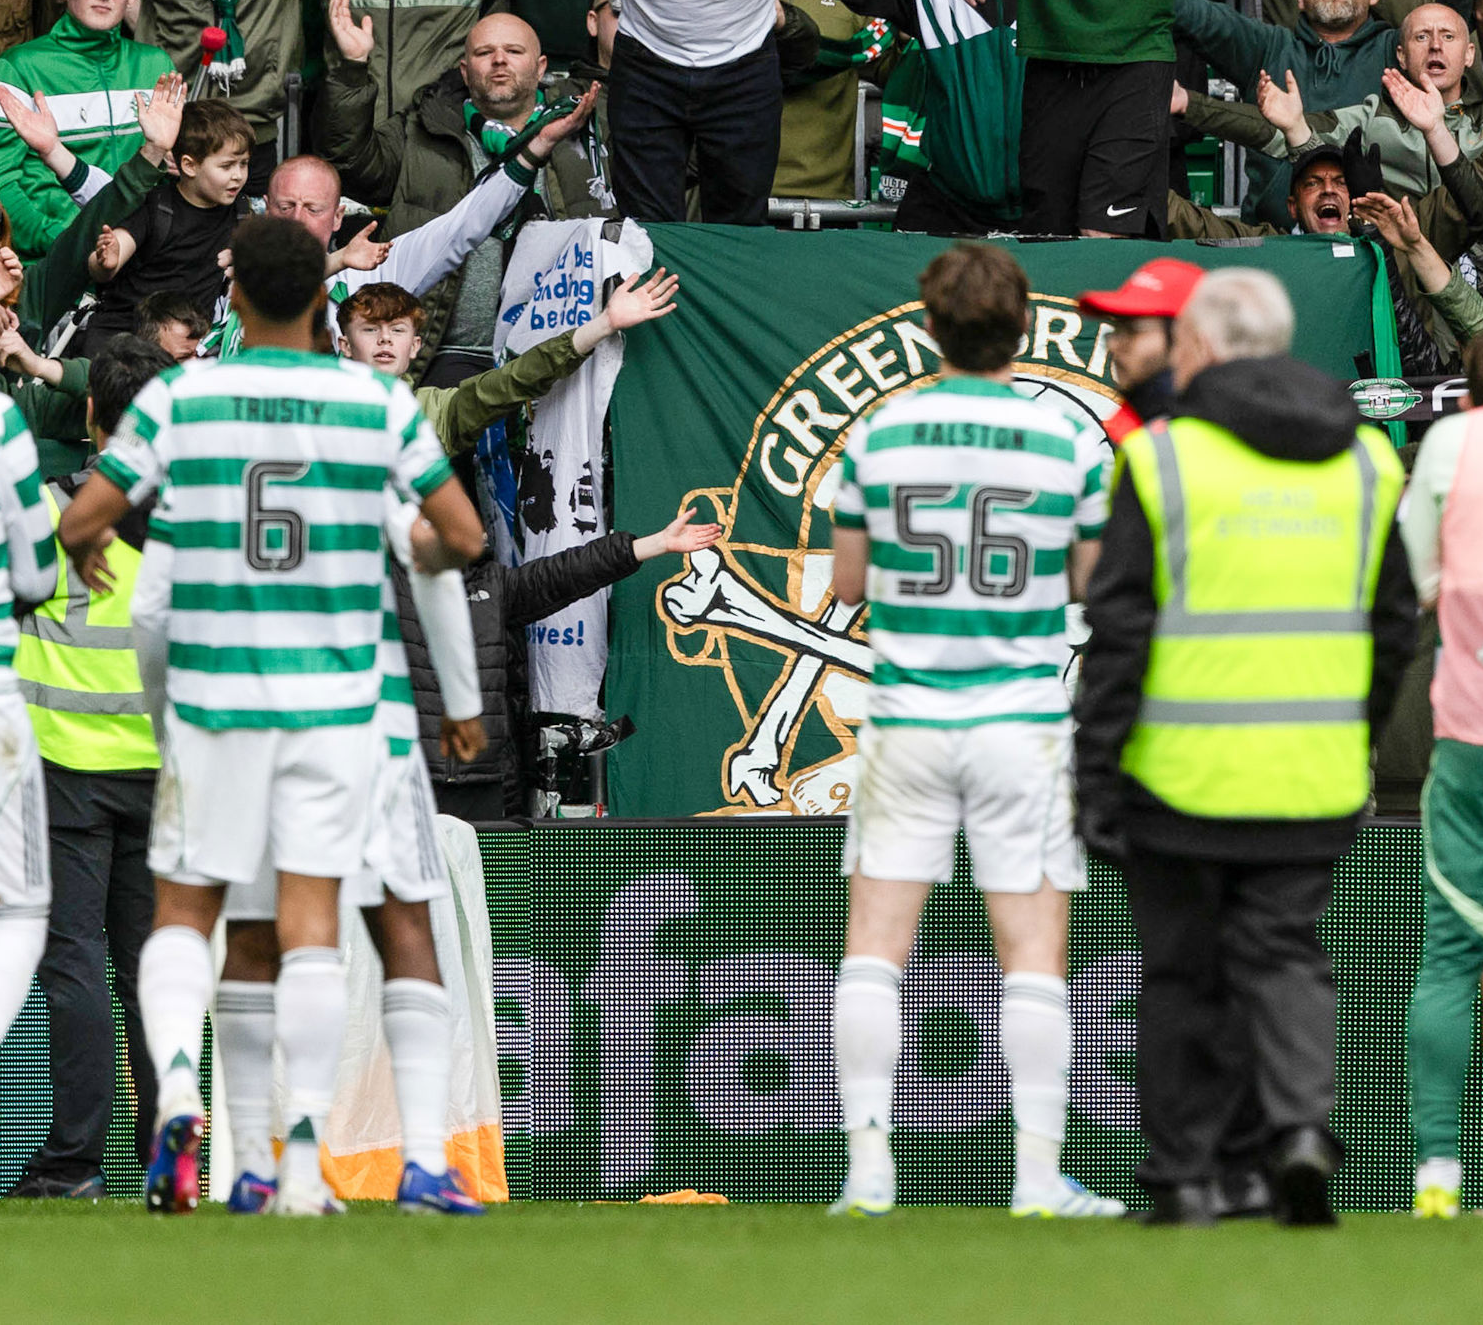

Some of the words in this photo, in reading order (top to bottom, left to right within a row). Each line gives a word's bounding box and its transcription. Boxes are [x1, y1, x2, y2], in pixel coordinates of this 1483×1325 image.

[232, 396, 325, 423] TRUSTY
[912, 420, 1028, 449] RALSTON
[244, 459, 311, 571] 6
[892, 484, 1037, 597] 56
